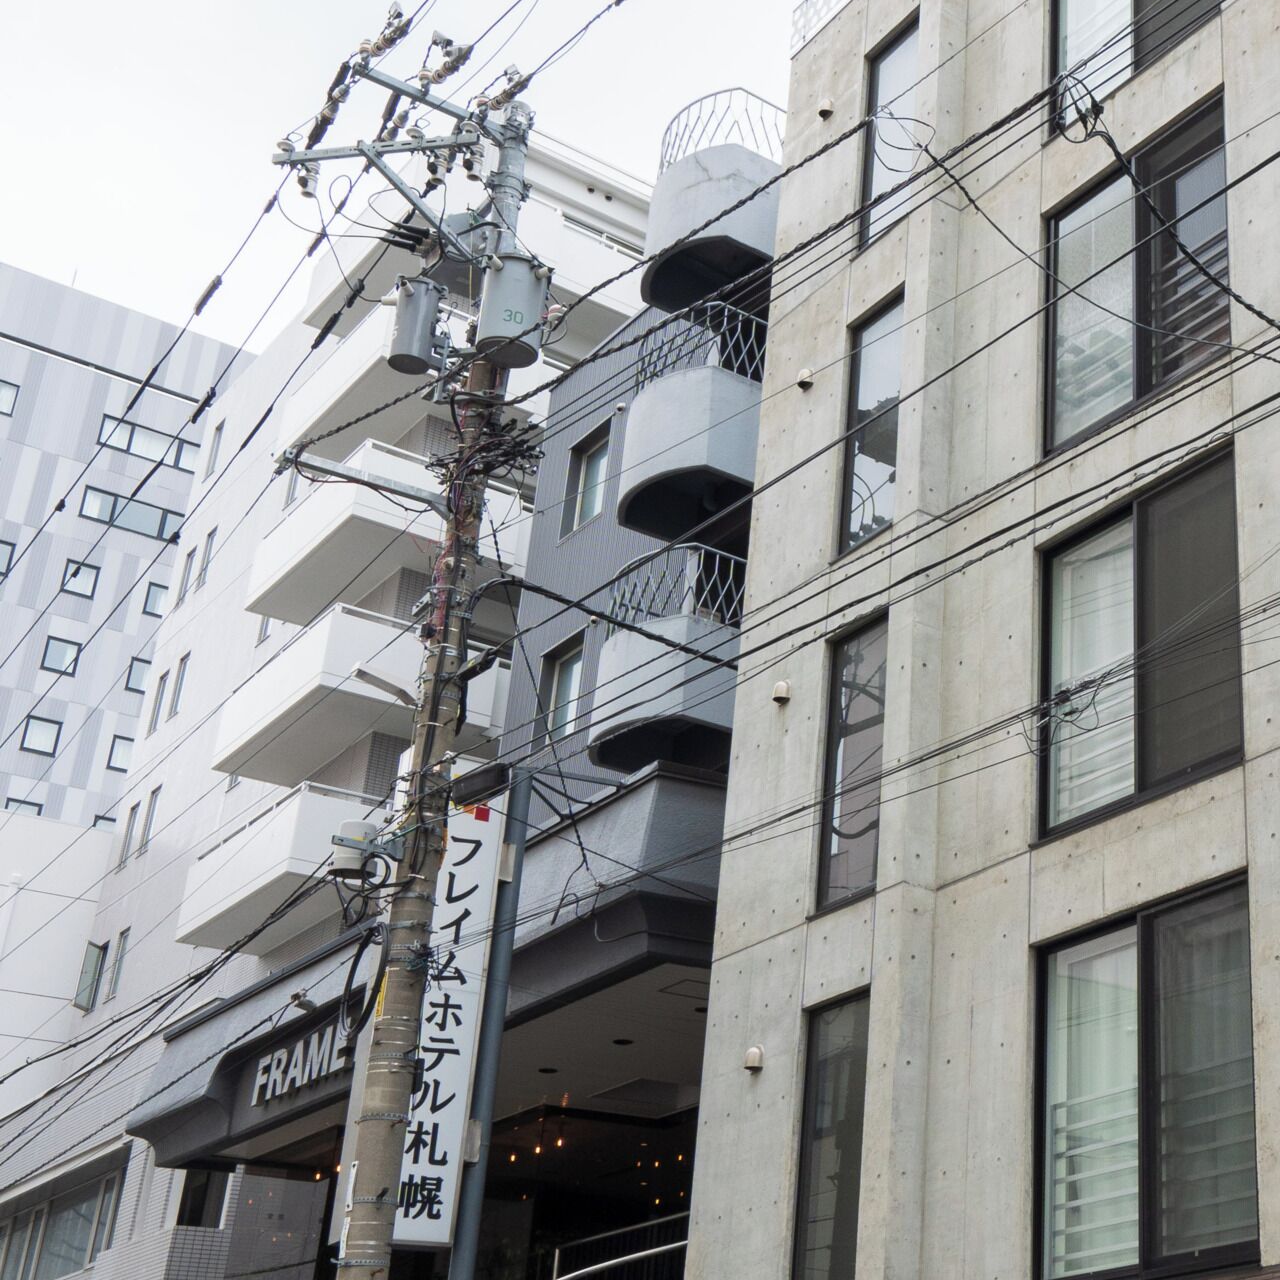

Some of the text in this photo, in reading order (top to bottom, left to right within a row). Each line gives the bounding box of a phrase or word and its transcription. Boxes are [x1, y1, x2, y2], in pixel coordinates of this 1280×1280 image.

[503, 309, 524, 325] 30
[251, 1017, 351, 1107] FRAME
[399, 835, 483, 1220] フレイムホテル札幌
